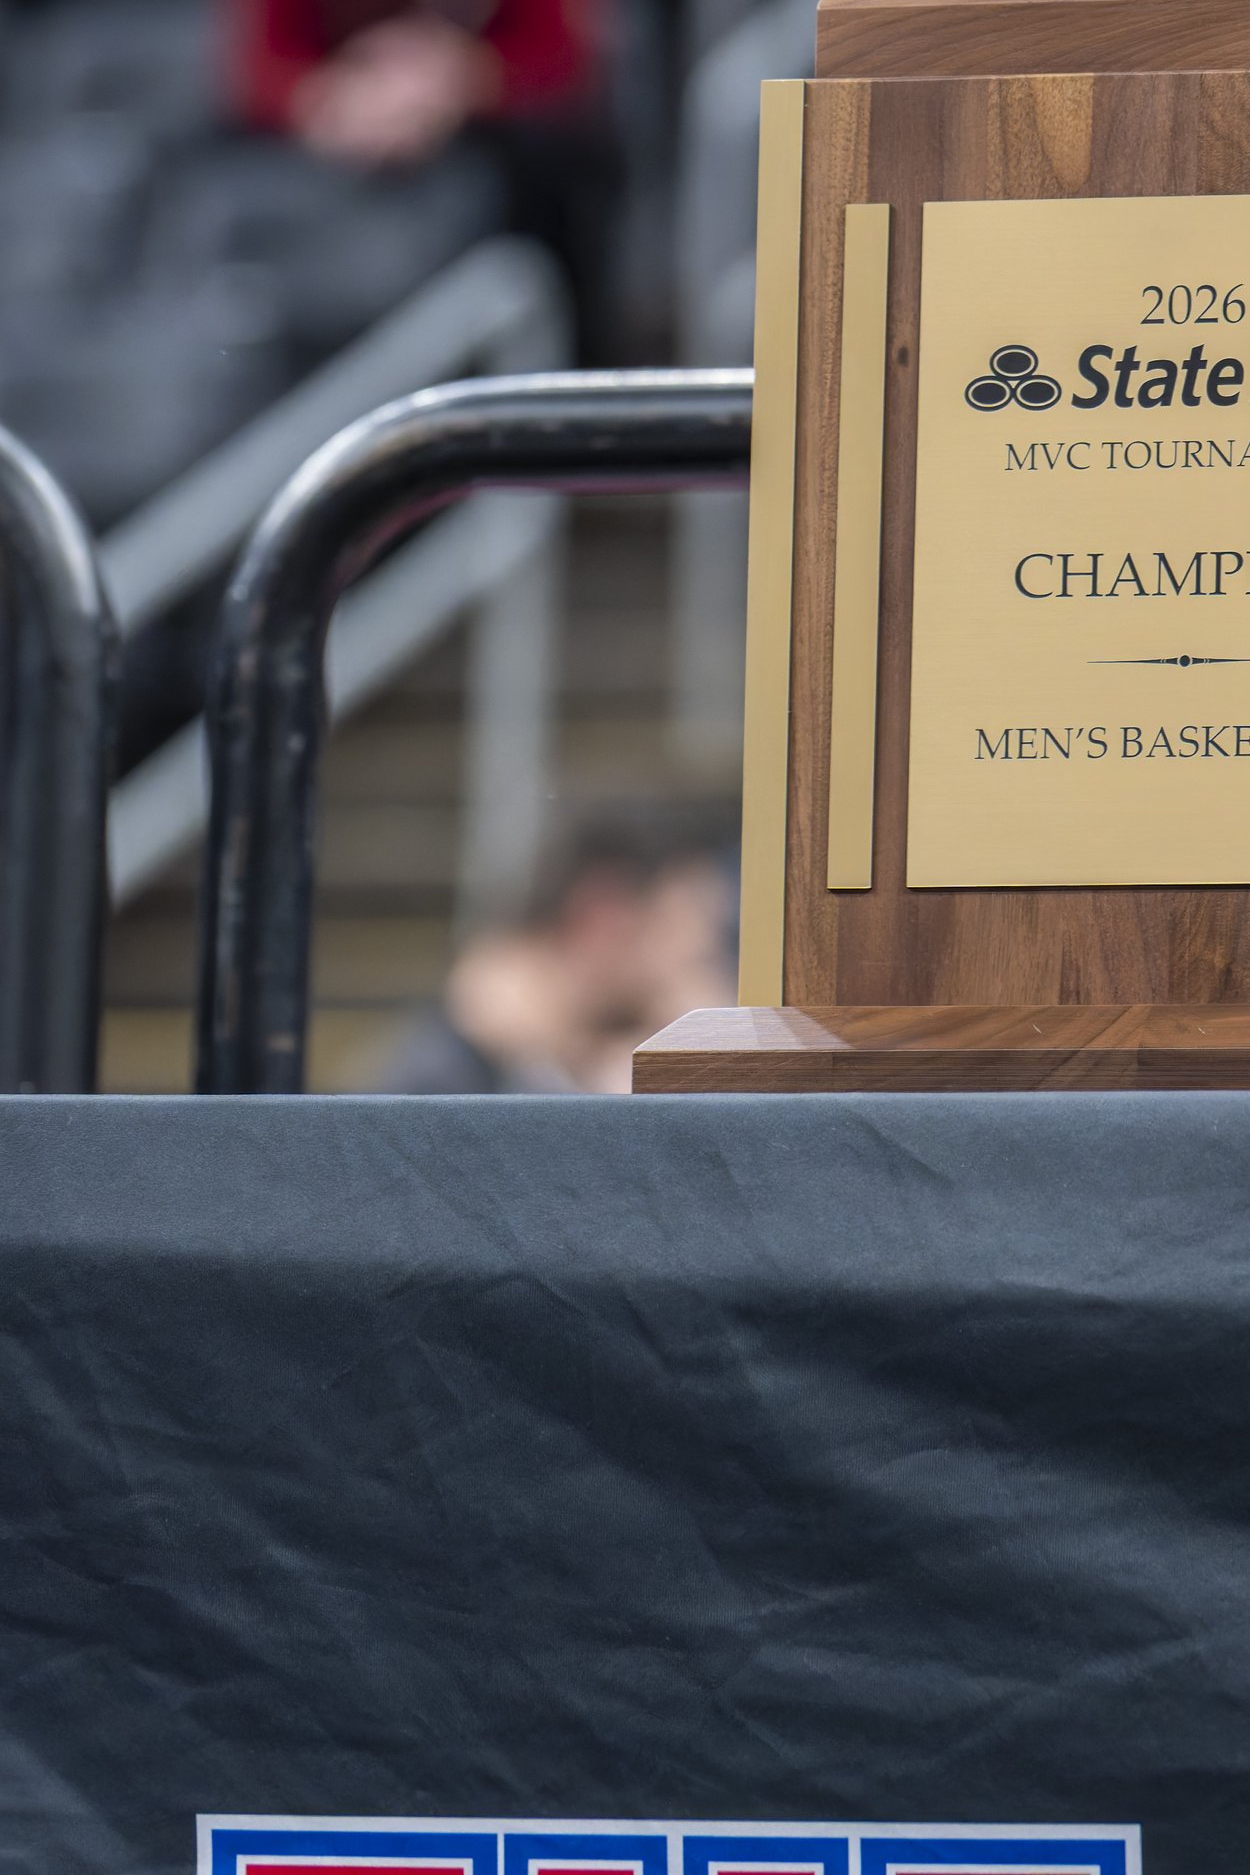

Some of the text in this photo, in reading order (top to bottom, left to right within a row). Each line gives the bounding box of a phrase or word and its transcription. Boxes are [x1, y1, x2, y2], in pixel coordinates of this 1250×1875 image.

[1140, 283, 1246, 325] 2026
[1004, 441, 1091, 471] MVC
[974, 726, 1109, 761] MEN'S
